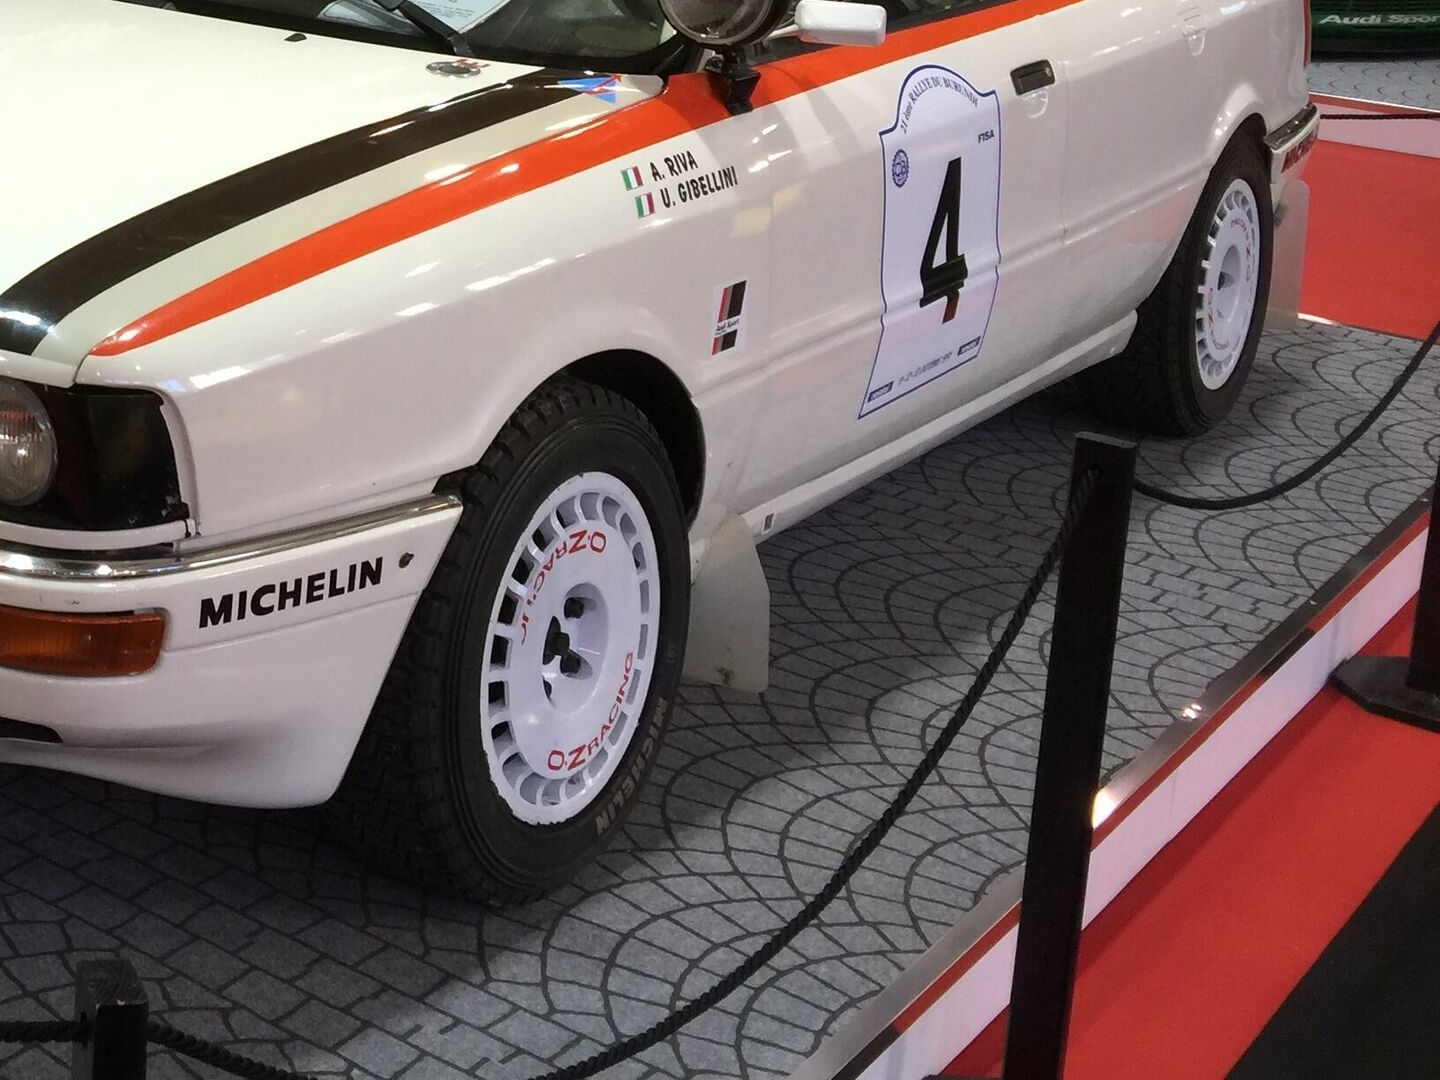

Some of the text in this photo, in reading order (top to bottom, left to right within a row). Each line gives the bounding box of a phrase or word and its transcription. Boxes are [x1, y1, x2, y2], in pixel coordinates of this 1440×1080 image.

[1319, 15, 1382, 25] Audi
[977, 128, 995, 144] FISA
[649, 150, 699, 182] A. RIVA
[659, 165, 739, 209] U. GIBELLINI
[919, 156, 969, 324] 4
[199, 556, 383, 628] MICHELIN
